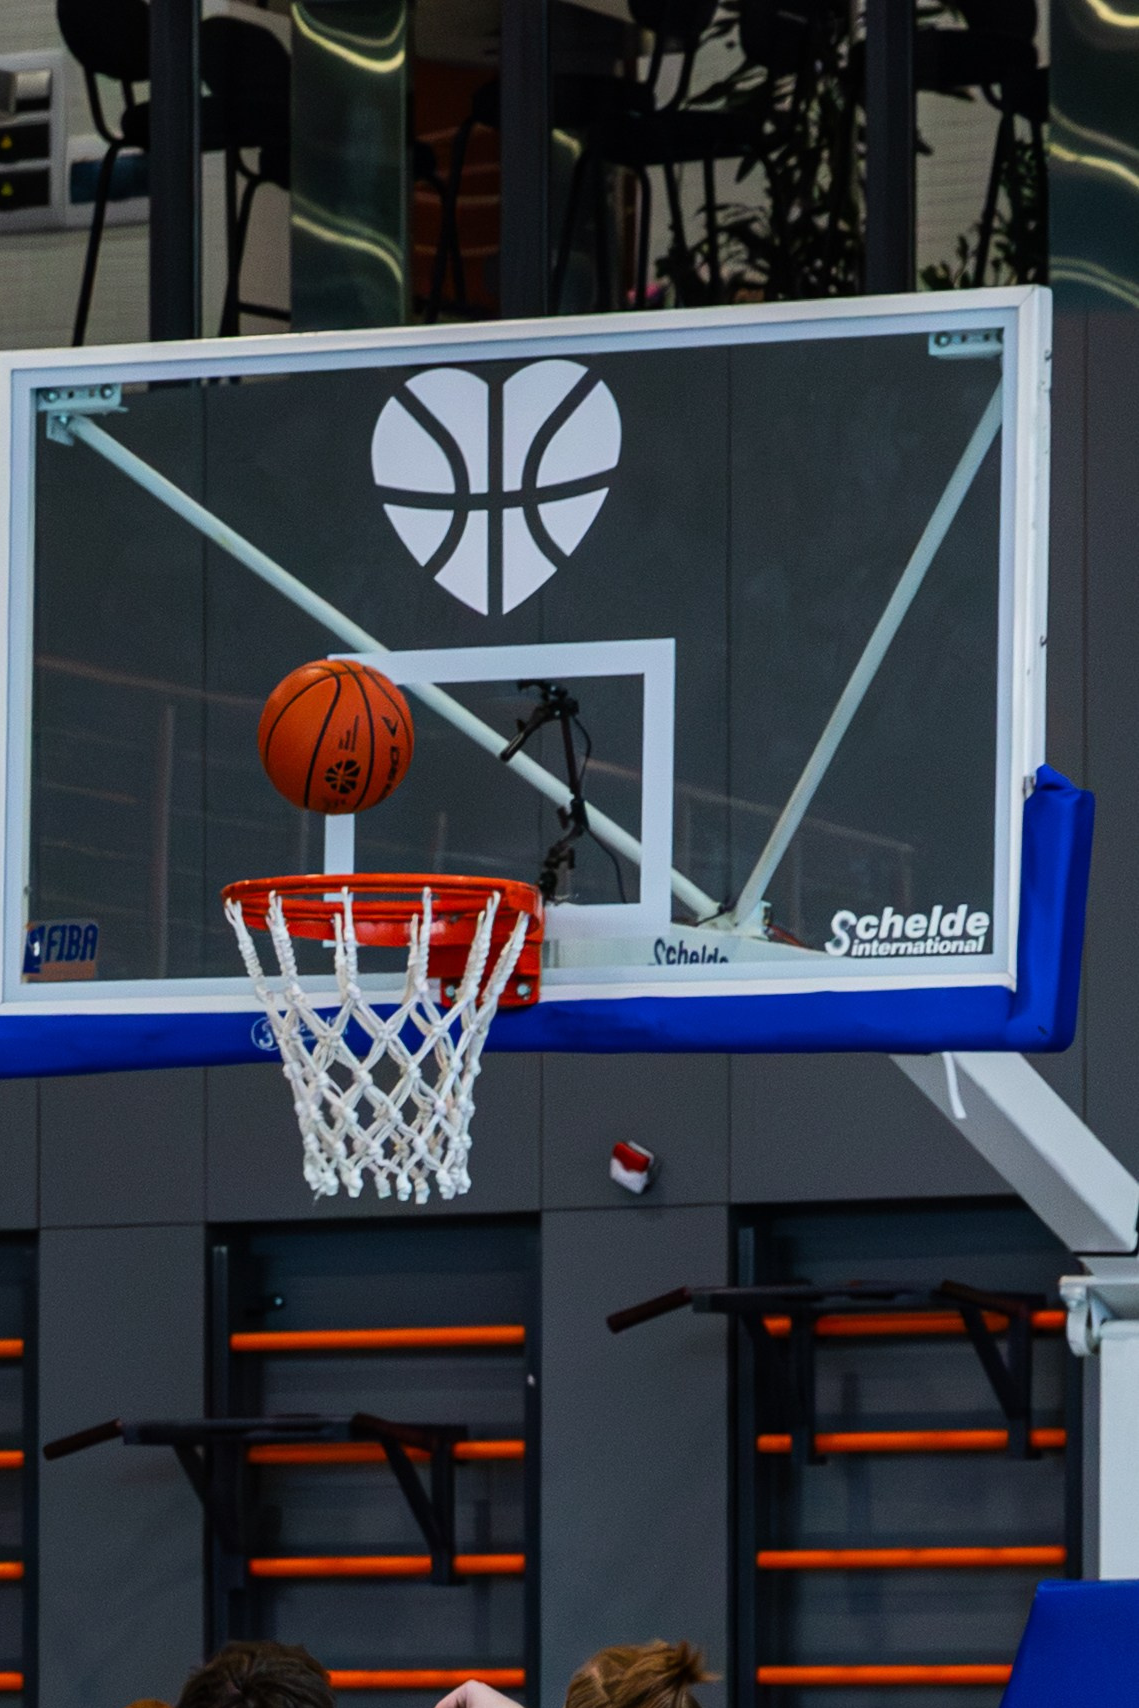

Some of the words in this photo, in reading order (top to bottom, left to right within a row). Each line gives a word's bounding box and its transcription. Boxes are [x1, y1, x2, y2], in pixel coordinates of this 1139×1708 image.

[45, 924, 98, 961] FIBA
[825, 903, 990, 957] Schelde
[851, 935, 985, 957] international
